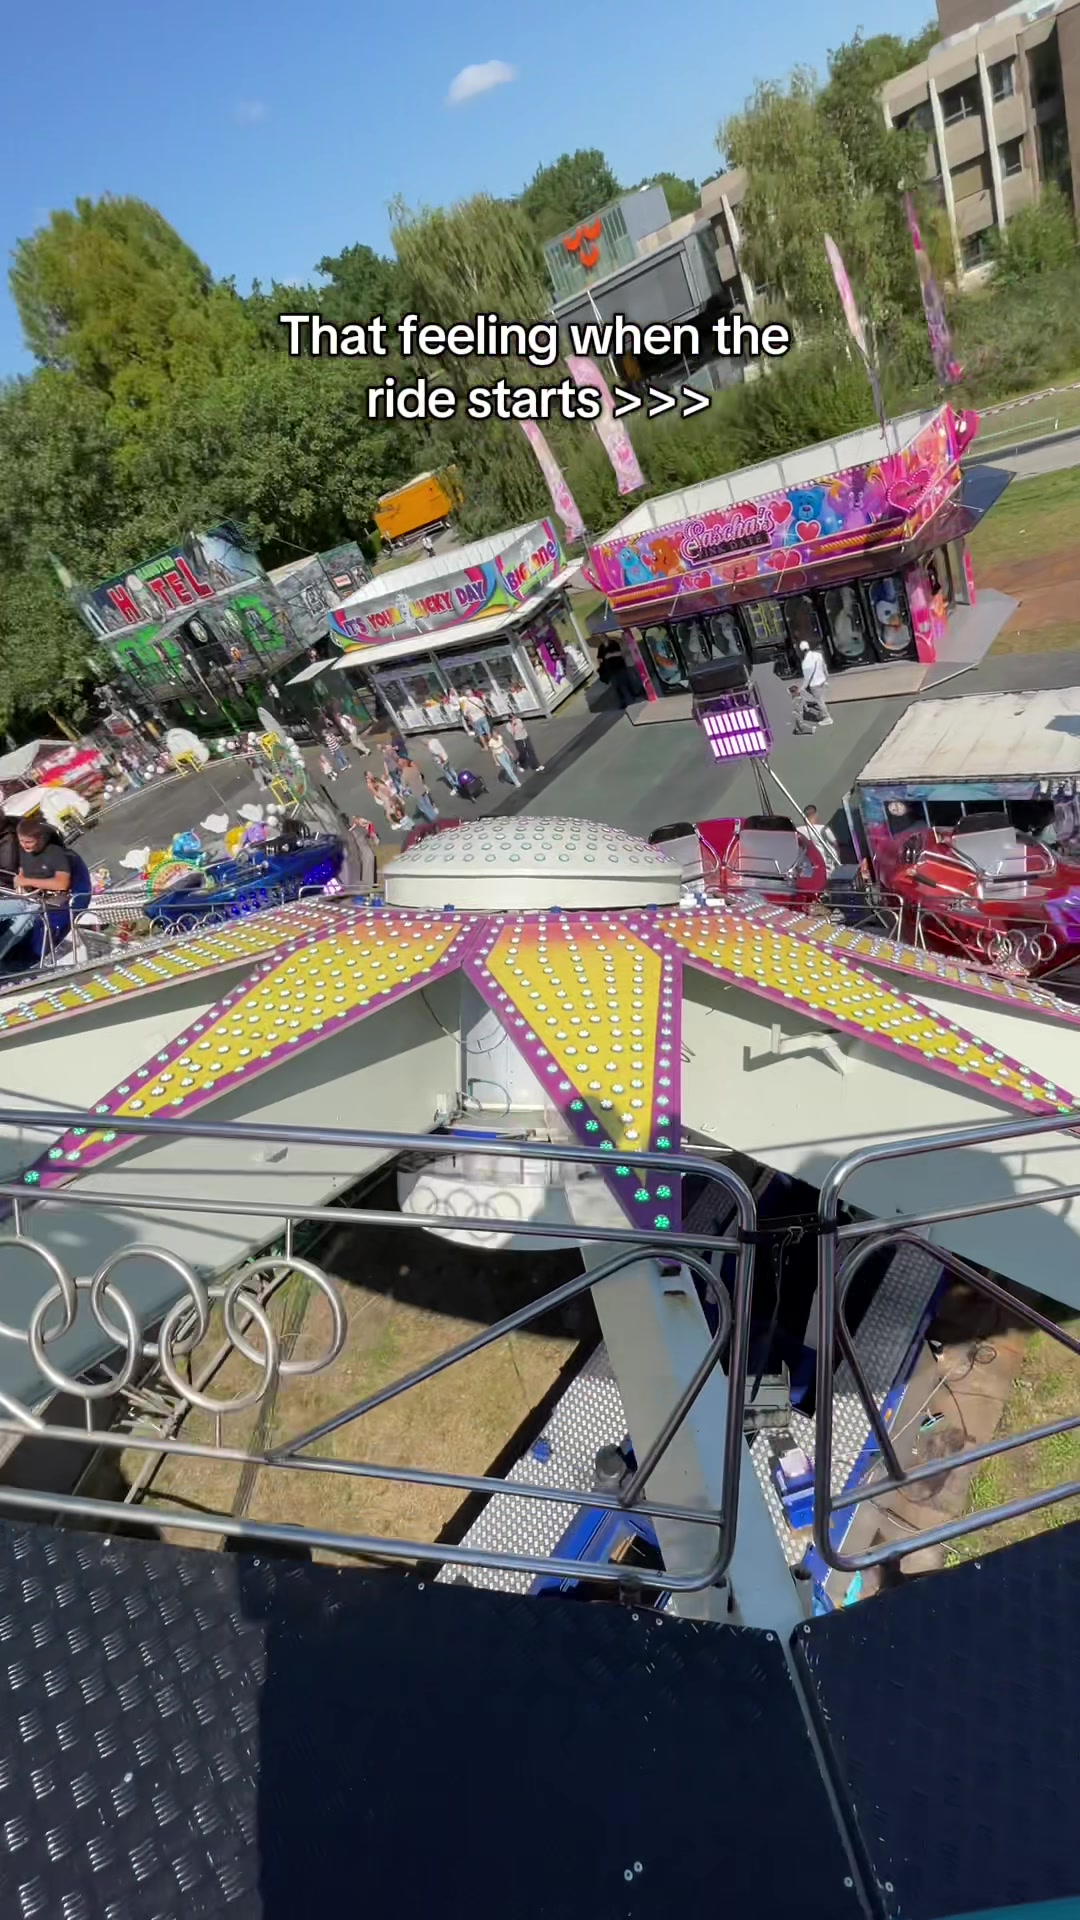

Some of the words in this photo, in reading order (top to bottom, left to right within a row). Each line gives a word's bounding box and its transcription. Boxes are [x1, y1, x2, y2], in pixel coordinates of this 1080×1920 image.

[681, 507, 775, 559] Sascha's
[729, 535, 763, 551] DATE
[106, 556, 215, 624] HTEL
[343, 616, 369, 638] IT'S
[408, 590, 454, 619] LUCKY
[454, 580, 486, 607] DAY
